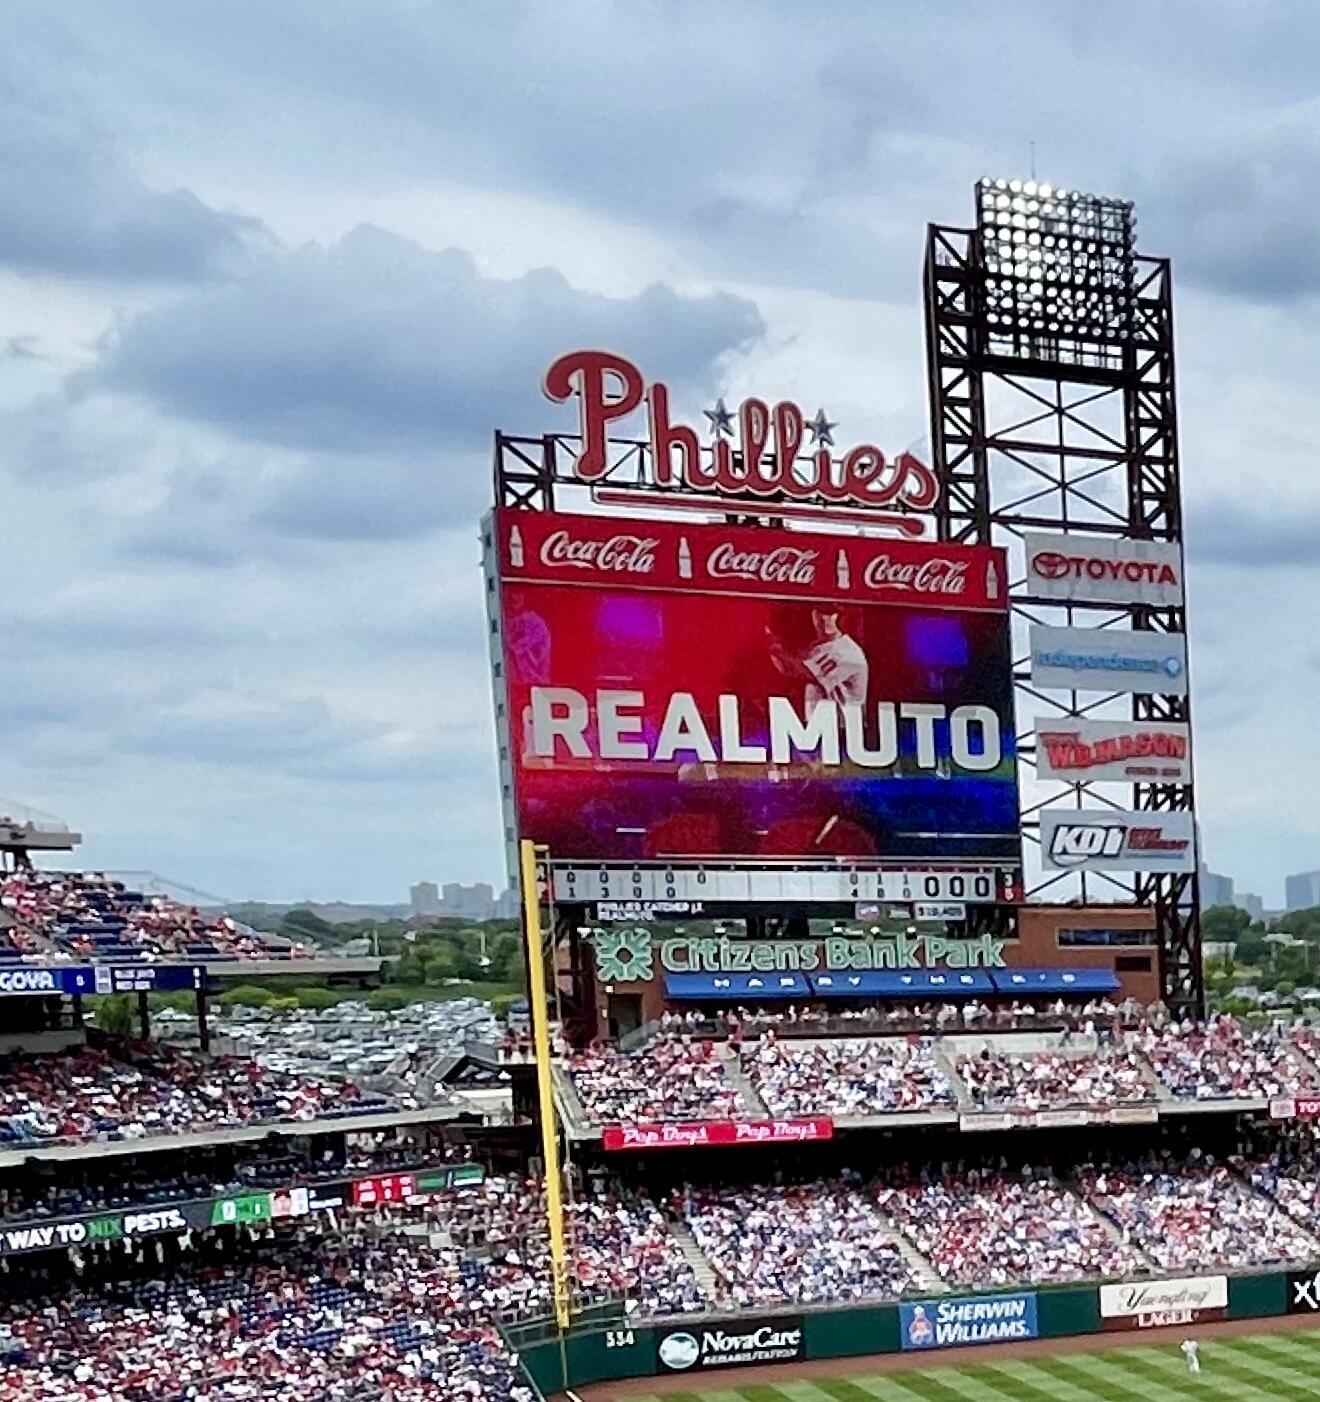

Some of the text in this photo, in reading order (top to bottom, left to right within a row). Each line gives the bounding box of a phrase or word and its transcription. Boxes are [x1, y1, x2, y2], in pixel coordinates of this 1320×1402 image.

[543, 350, 941, 508] Phillies
[1069, 557, 1178, 585] TOYOTA
[530, 686, 1001, 771] REALMUTO
[661, 933, 1005, 972] Citizens Bank Park
[7, 1226, 54, 1250] WAY
[56, 1222, 86, 1243] TO
[937, 1300, 1027, 1322] SHERWIN
[702, 1327, 800, 1353] NovaCare
